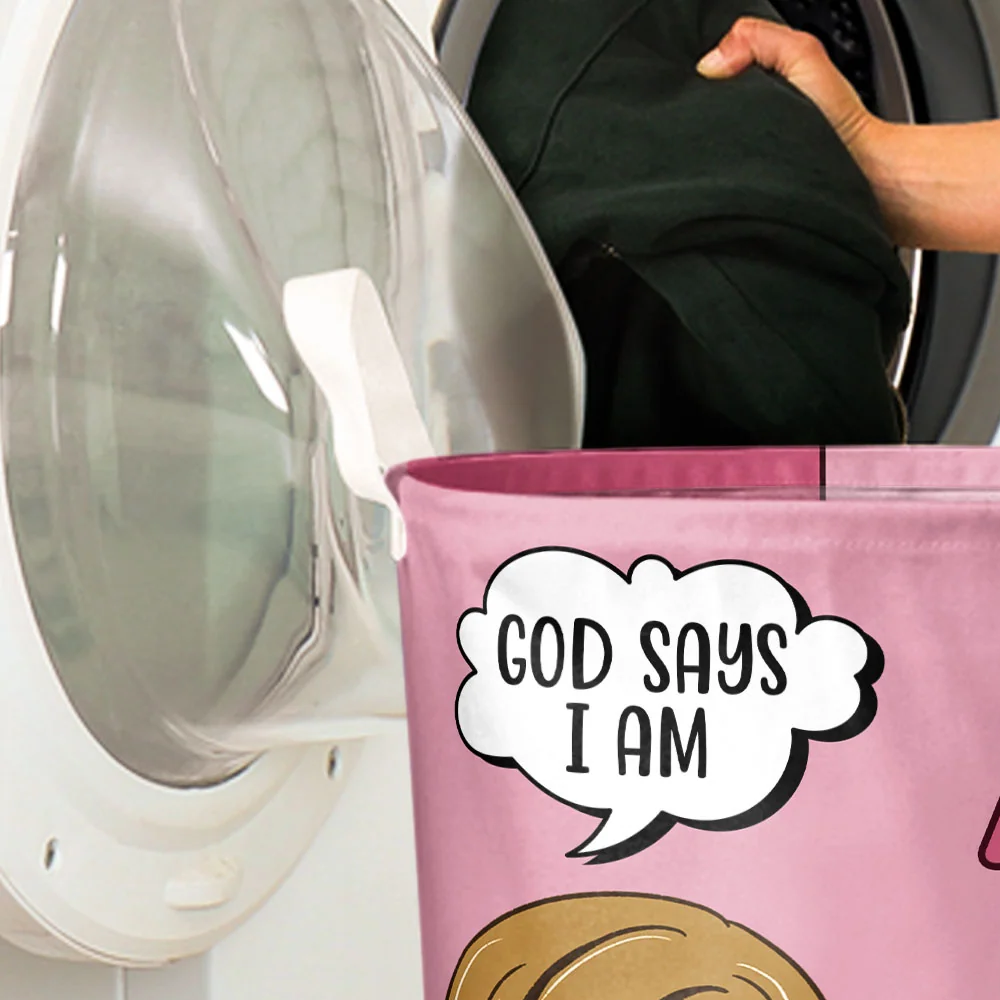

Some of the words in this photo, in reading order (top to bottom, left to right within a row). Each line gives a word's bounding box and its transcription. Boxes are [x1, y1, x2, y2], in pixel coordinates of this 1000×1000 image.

[497, 614, 613, 689] GOD
[640, 620, 788, 696] SAYS
[566, 702, 590, 774] I
[617, 704, 708, 778] AM
